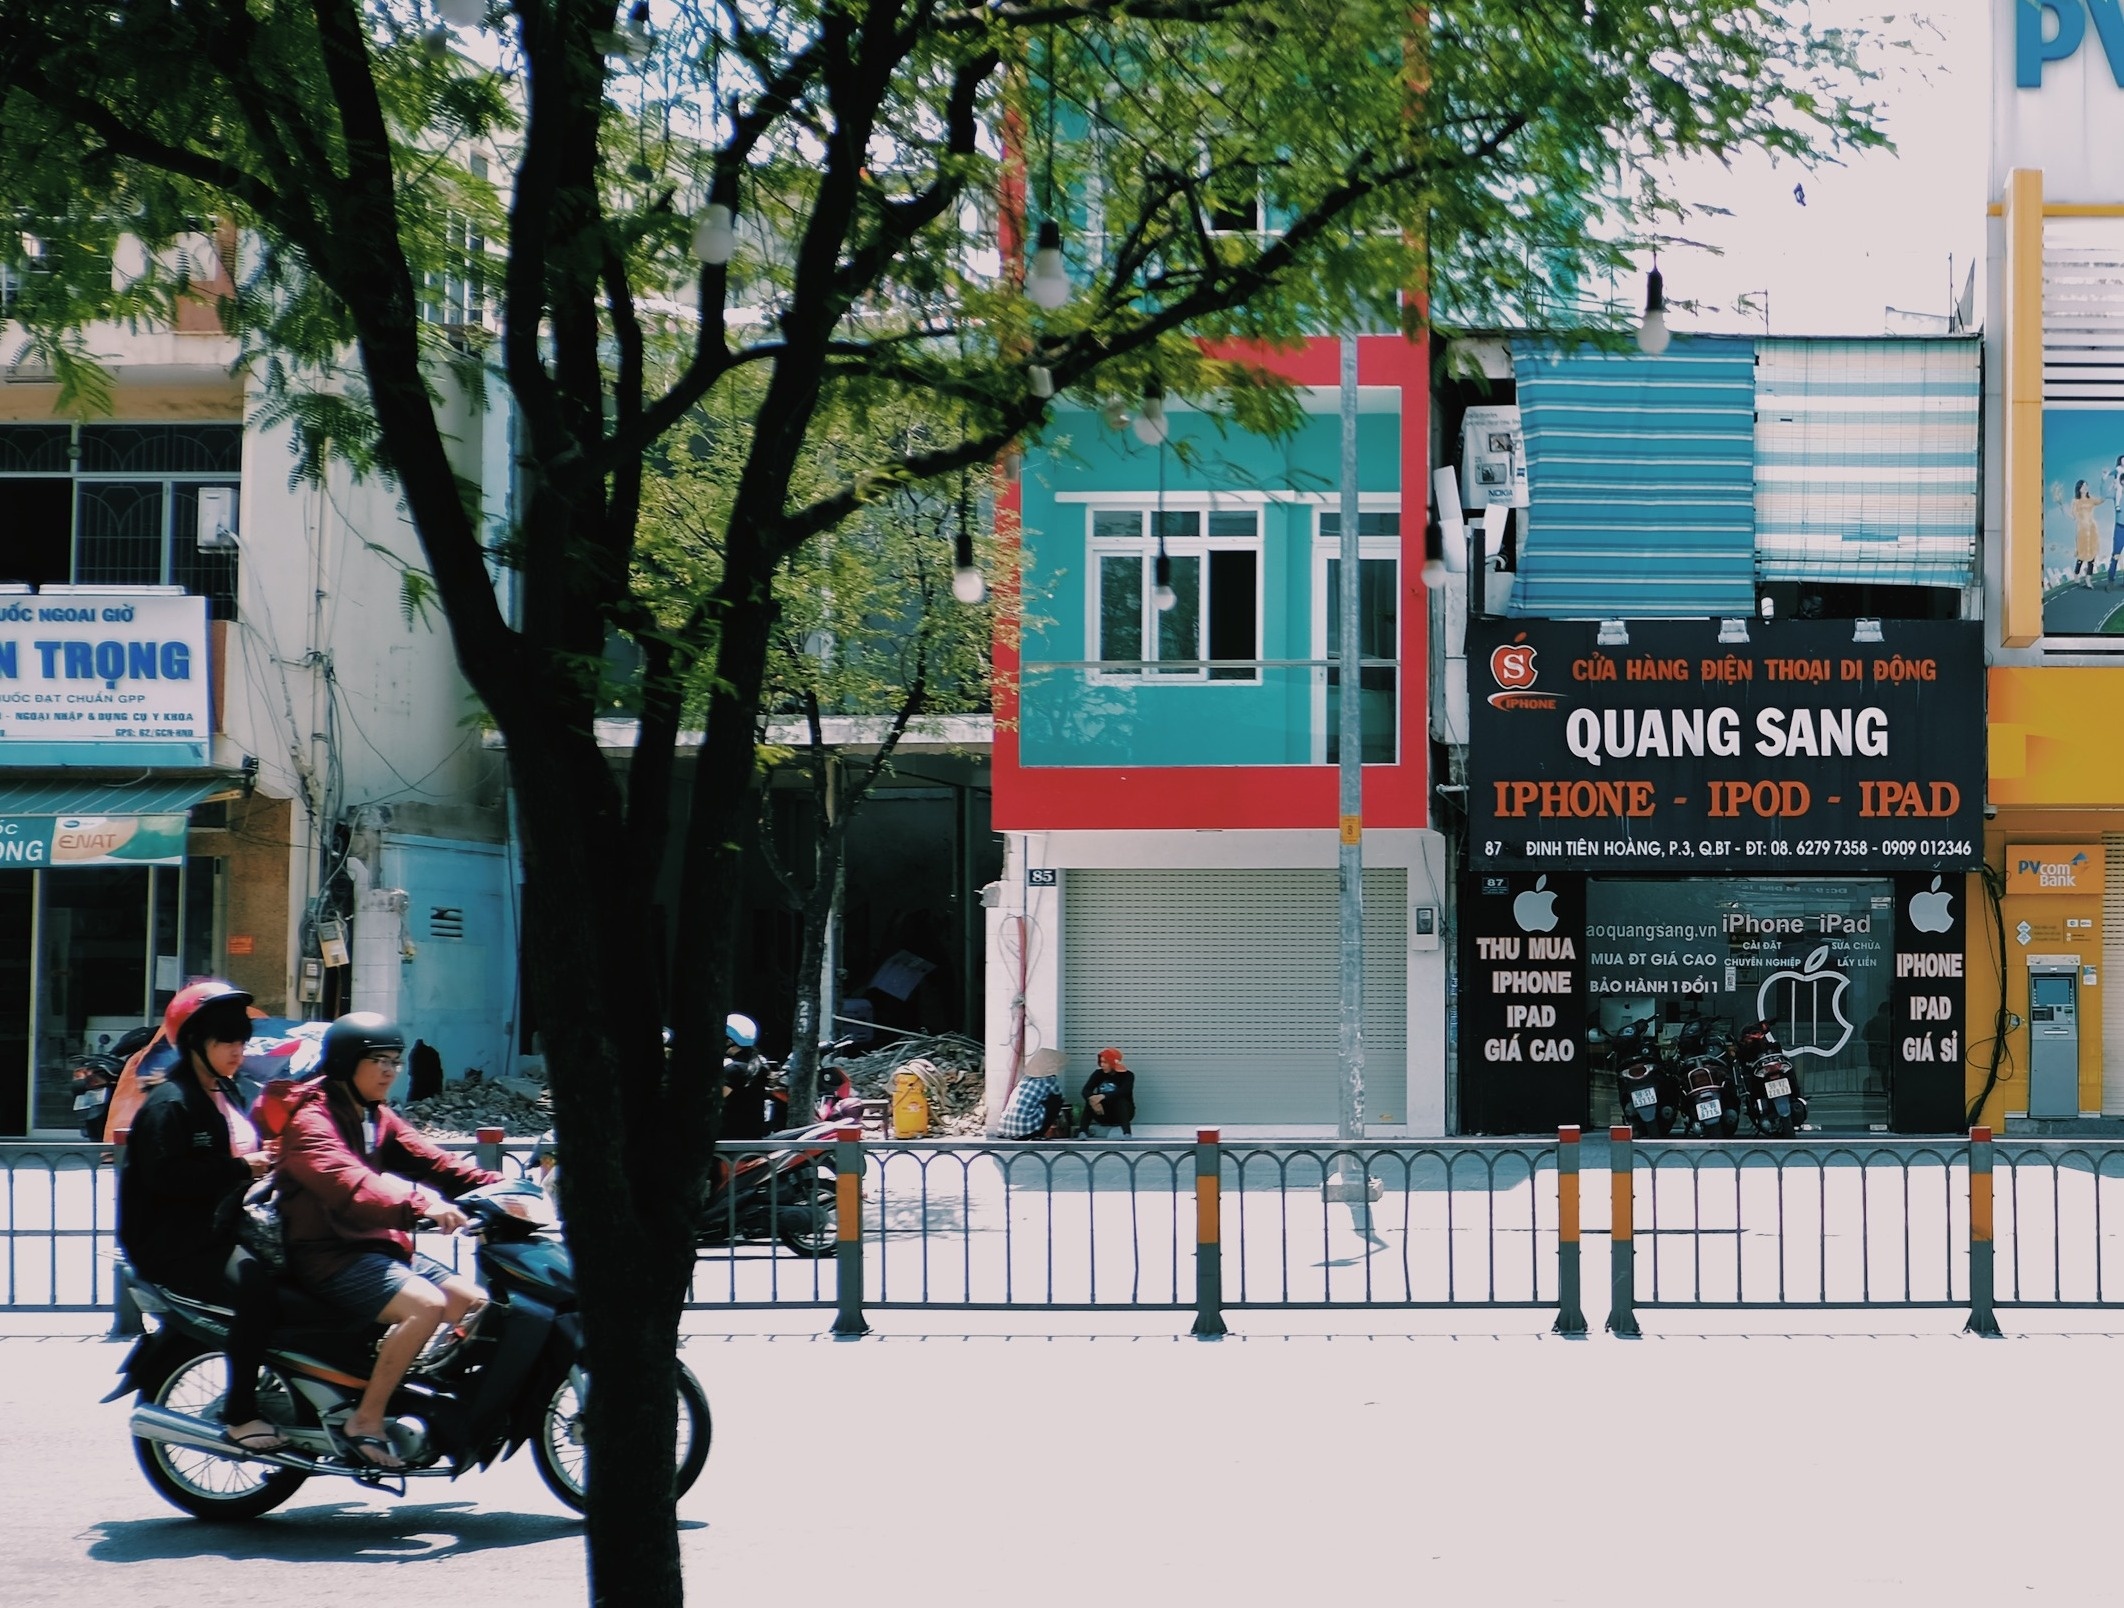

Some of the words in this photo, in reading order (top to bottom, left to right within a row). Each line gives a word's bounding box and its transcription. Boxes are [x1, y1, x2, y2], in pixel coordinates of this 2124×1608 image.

[102, 604, 135, 622] GIỜ
[34, 640, 190, 689] TRỌNG
[1503, 653, 1526, 679] S
[1572, 651, 1617, 681] CỬA
[1626, 653, 1689, 681] HÀNG
[1701, 654, 1752, 686] ĐIỆN
[1764, 659, 1830, 686] THOẠI
[1841, 659, 1863, 681] DI
[1873, 654, 1937, 686] ĐỘNG
[0, 691, 31, 703] UỐC
[34, 694, 62, 704] ĐẠT
[118, 694, 146, 704] GPP
[1505, 698, 1557, 710] IPHONE
[88, 712, 95, 720] &
[153, 712, 159, 721] Y
[163, 712, 193, 721] KHOA
[1566, 707, 1740, 766] QUANG
[1755, 707, 1888, 757] SANG
[1493, 780, 1656, 818] IPHONE
[1707, 780, 1811, 817] IPOD
[1859, 781, 1960, 817] IPAD
[58, 834, 116, 849] ENAT
[1485, 841, 1502, 856] 87
[1526, 841, 1562, 856] ĐINH
[1566, 838, 1599, 856] TIÊN
[1604, 837, 1665, 857] HOÀNG,
[1669, 841, 1694, 857] P.3,
[1699, 841, 1731, 856] Q.BT
[1746, 841, 1767, 855] ĐT:
[1771, 841, 1793, 855] 08.
[1796, 840, 1831, 855] 6279
[1834, 841, 1868, 855] 7358
[1882, 841, 1917, 855] 0909
[1921, 840, 1972, 855] 012346
[1032, 870, 1054, 882] 85
[1487, 878, 1504, 887] 87
[2040, 874, 2077, 887] Bank
[1722, 913, 1804, 933] iPhone
[1820, 913, 1871, 933] iPad
[1585, 925, 1717, 941] aoquangsang.vn
[1476, 937, 1520, 960] THU
[1528, 937, 1576, 960] MUA
[1742, 940, 1760, 950] CÀI
[1591, 953, 1624, 965] MUA
[1628, 952, 1647, 965] ĐT
[1650, 950, 1679, 966] GIÁ
[1682, 953, 1717, 966] CAO
[1723, 957, 1763, 967] CHUYÊN
[1765, 957, 1802, 969] NGHIỆP
[1837, 955, 1854, 967] LẤY
[1896, 953, 1963, 977] IPHONE
[1492, 970, 1572, 994] IPHONE
[1590, 976, 1622, 993] BẢO
[1625, 977, 1668, 993] HÀNH
[1671, 981, 1678, 993] 1
[1681, 975, 1709, 993] ĐỔI
[1711, 981, 1718, 993] 1
[1506, 1005, 1556, 1028] IPAD
[1910, 996, 1952, 1020] IPAD
[1484, 1033, 1522, 1062] GIÁ
[1529, 1038, 1575, 1062] CAO
[1902, 1031, 1935, 1062] GIÁ
[1940, 1030, 1958, 1062] SỈ
